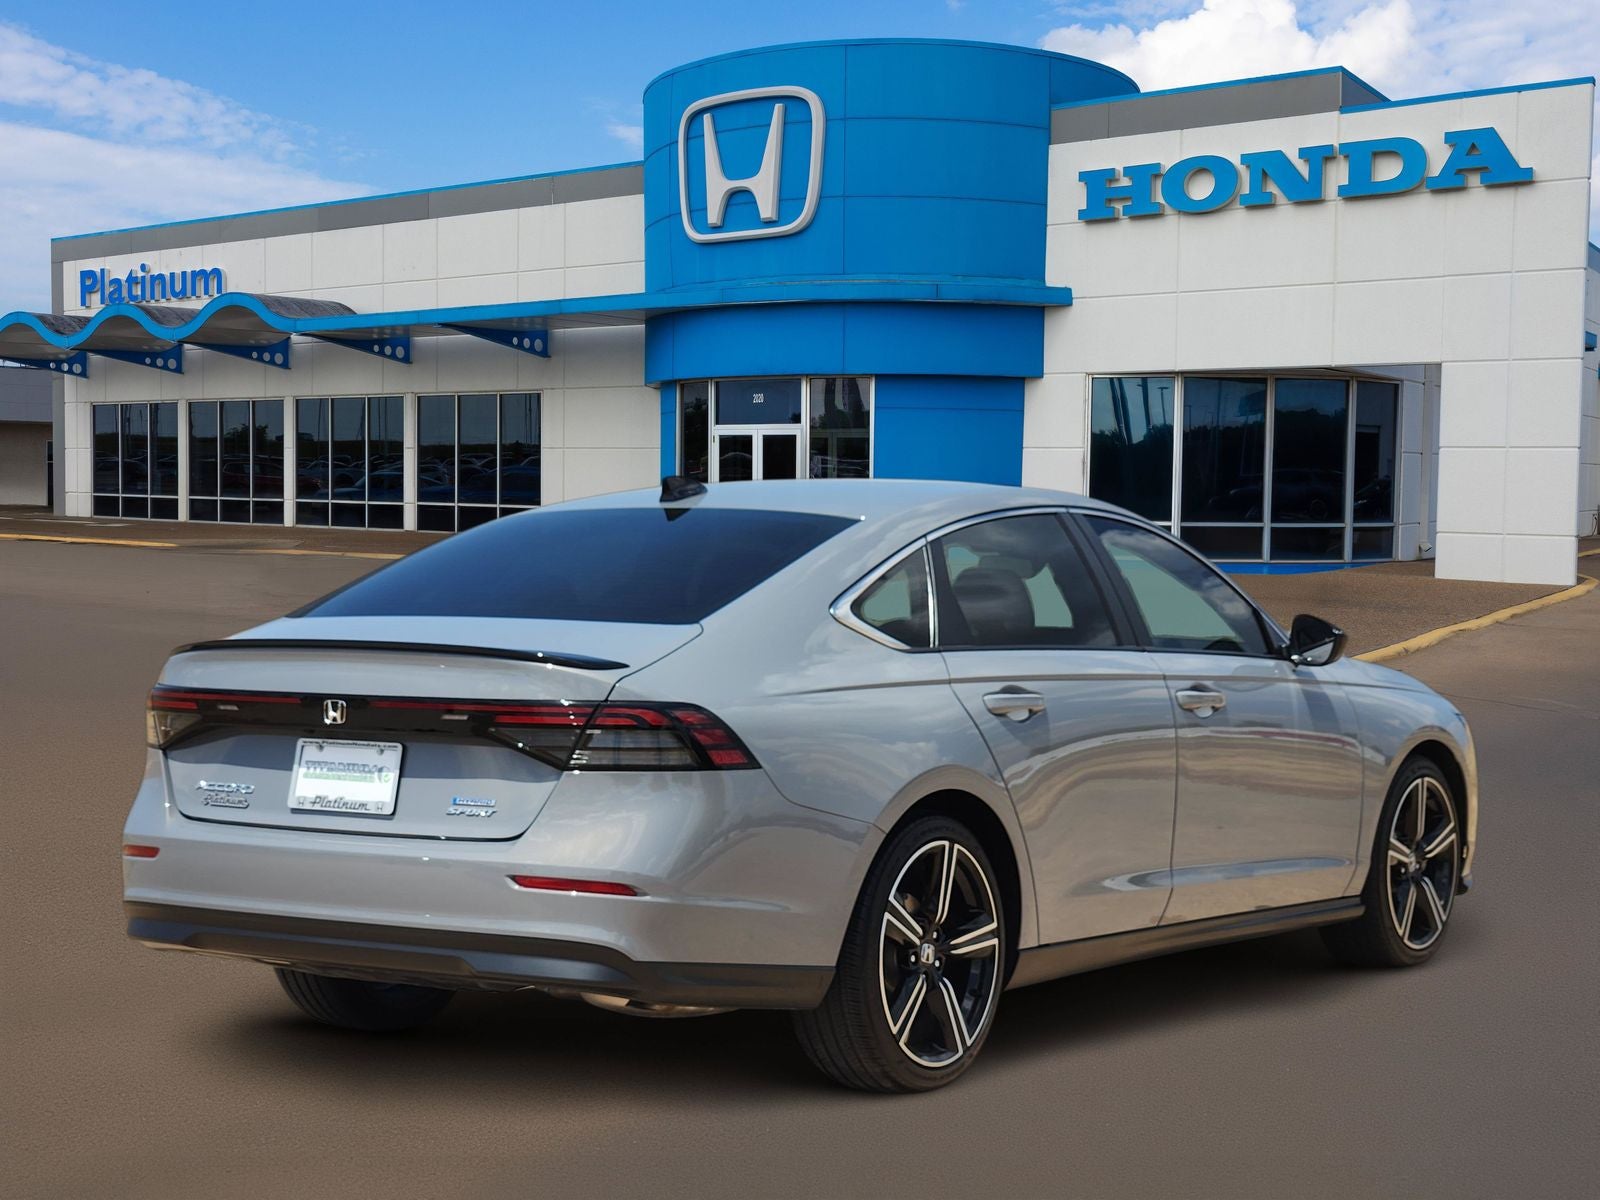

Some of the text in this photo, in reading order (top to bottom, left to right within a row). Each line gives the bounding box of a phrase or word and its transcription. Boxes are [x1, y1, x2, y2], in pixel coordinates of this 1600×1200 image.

[1078, 127, 1534, 222] HONDA
[79, 262, 224, 308] Platinum
[196, 780, 255, 795] ACCORD
[309, 795, 372, 812] Platinum
[445, 807, 497, 817] SPORT
